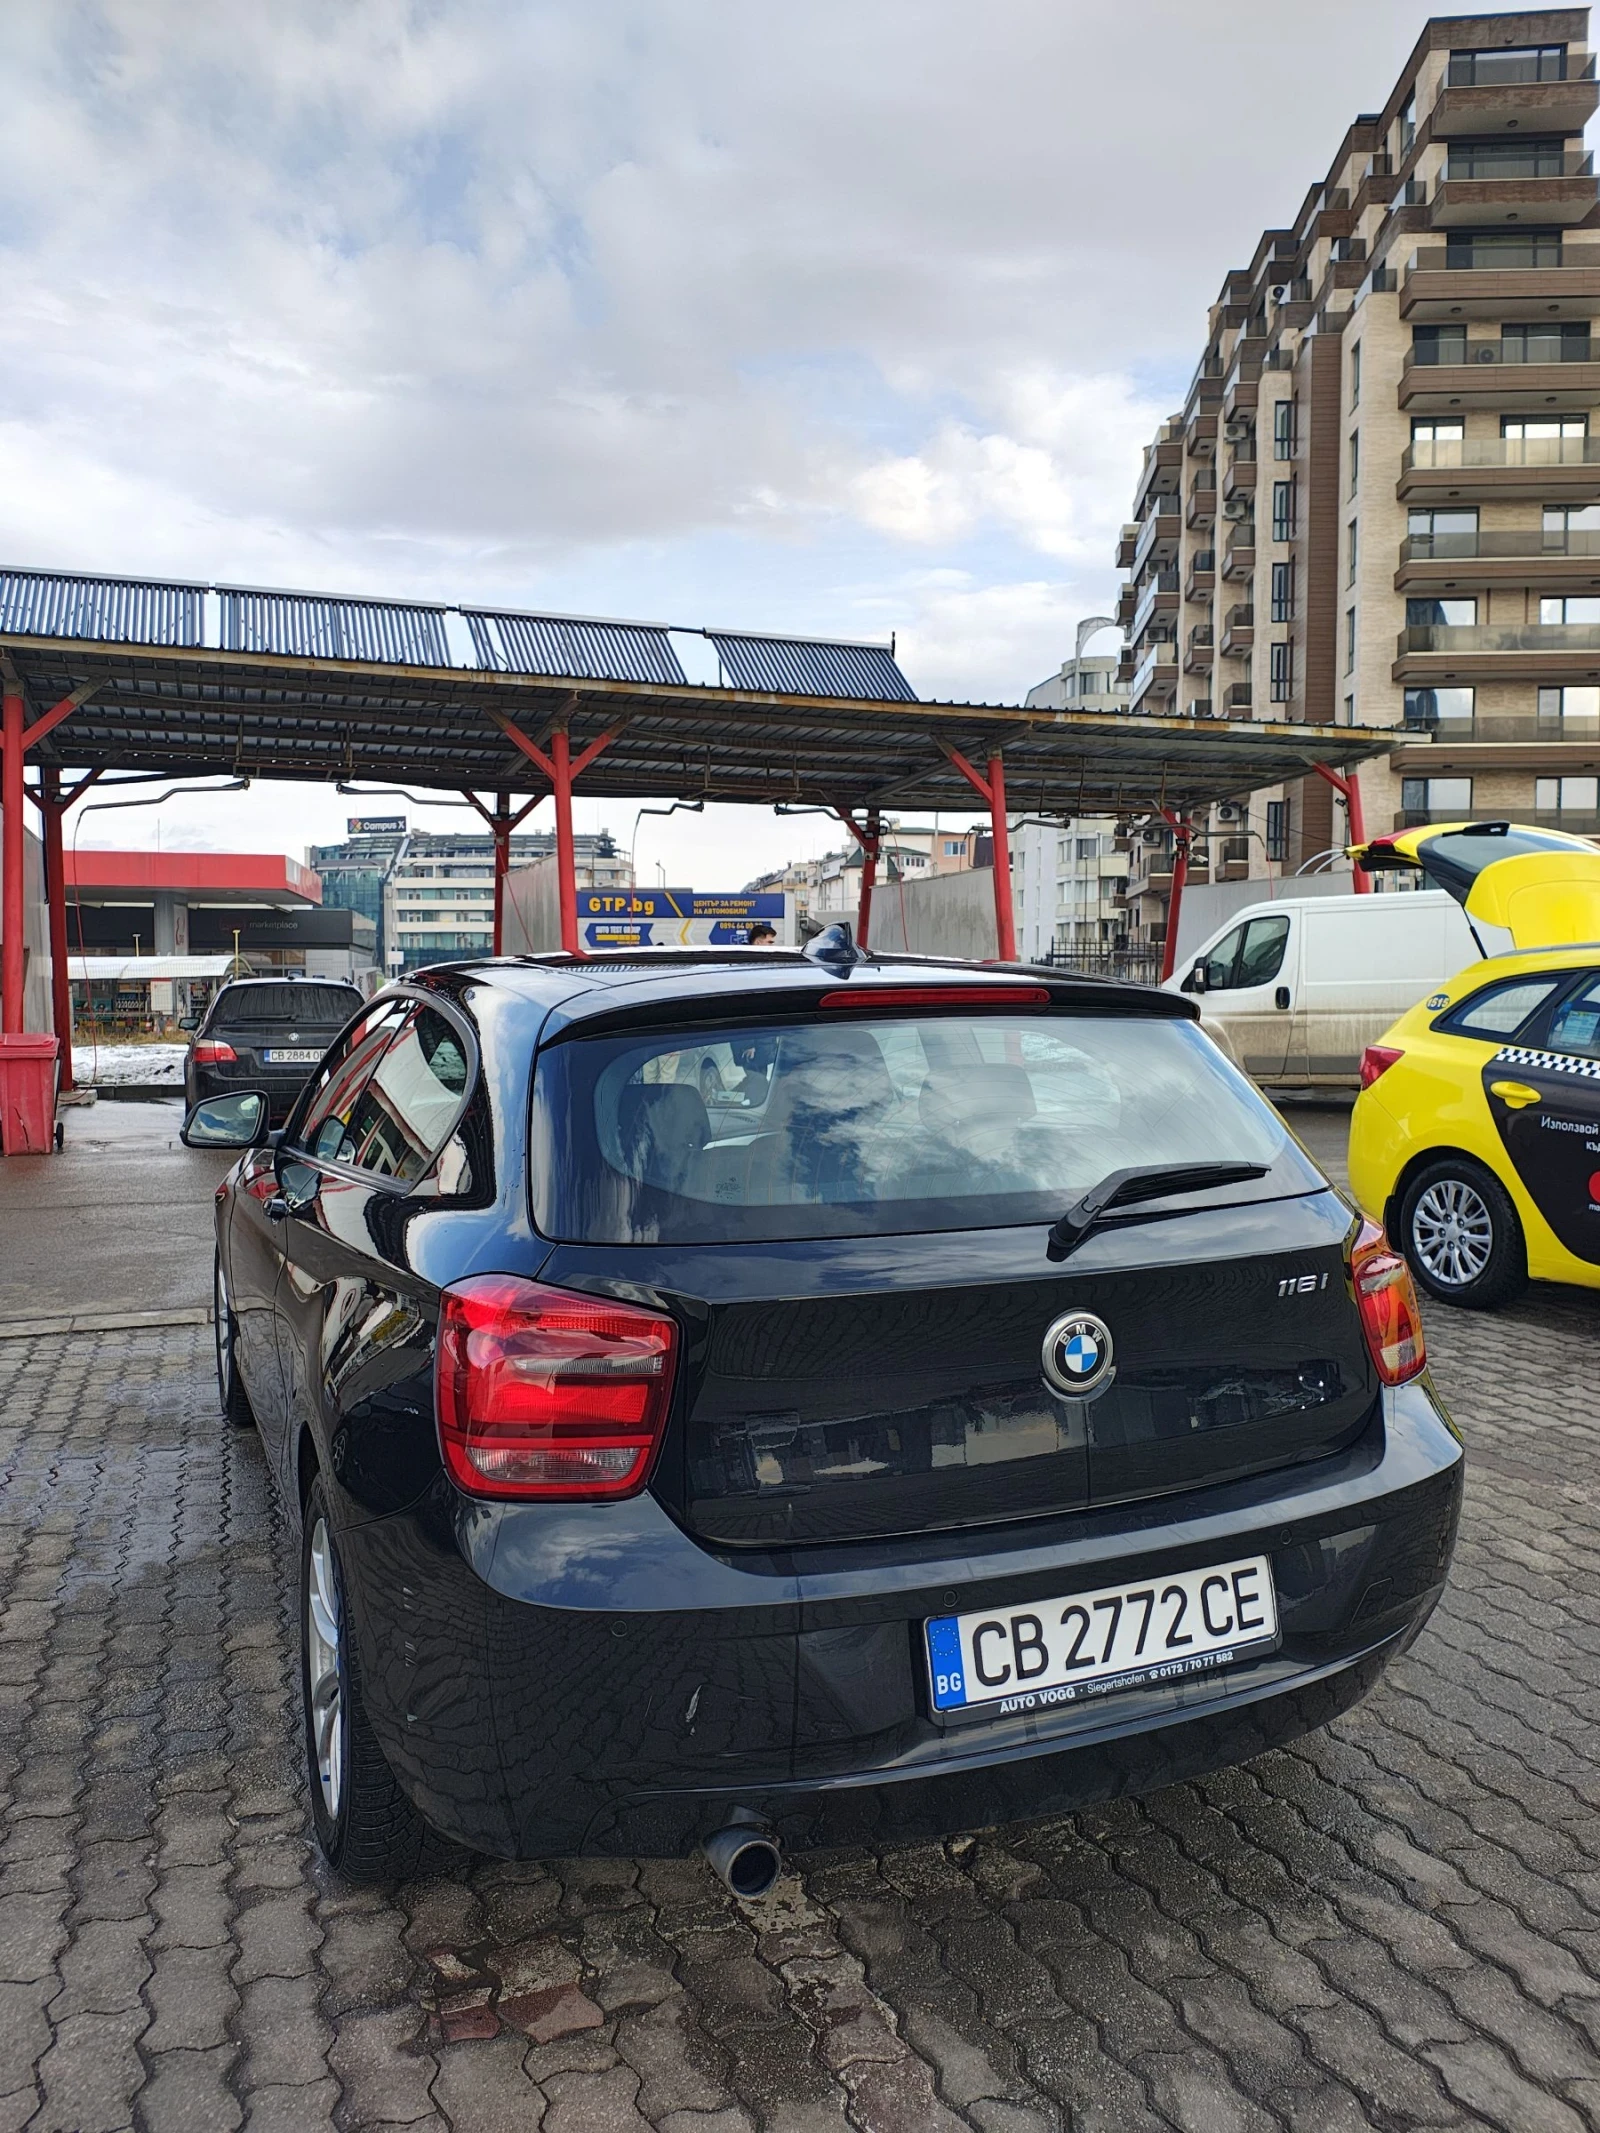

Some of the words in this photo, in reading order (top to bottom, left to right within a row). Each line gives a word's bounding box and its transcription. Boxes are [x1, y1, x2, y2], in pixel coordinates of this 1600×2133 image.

[363, 822, 396, 831] Campus
[398, 820, 404, 829] X
[589, 897, 654, 915] GTP.bg
[249, 921, 298, 929] marketplace
[1540, 1115, 1599, 1135] Използвай
[1059, 1323, 1104, 1346] BMW
[936, 1671, 962, 1696] BG
[1000, 1695, 1036, 1713] AUTO
[1039, 1686, 1076, 1704] VOGG
[1086, 1672, 1146, 1694] Siegertshofen
[1160, 1664, 1184, 1678] 0172
[1216, 1651, 1234, 1664] 582
